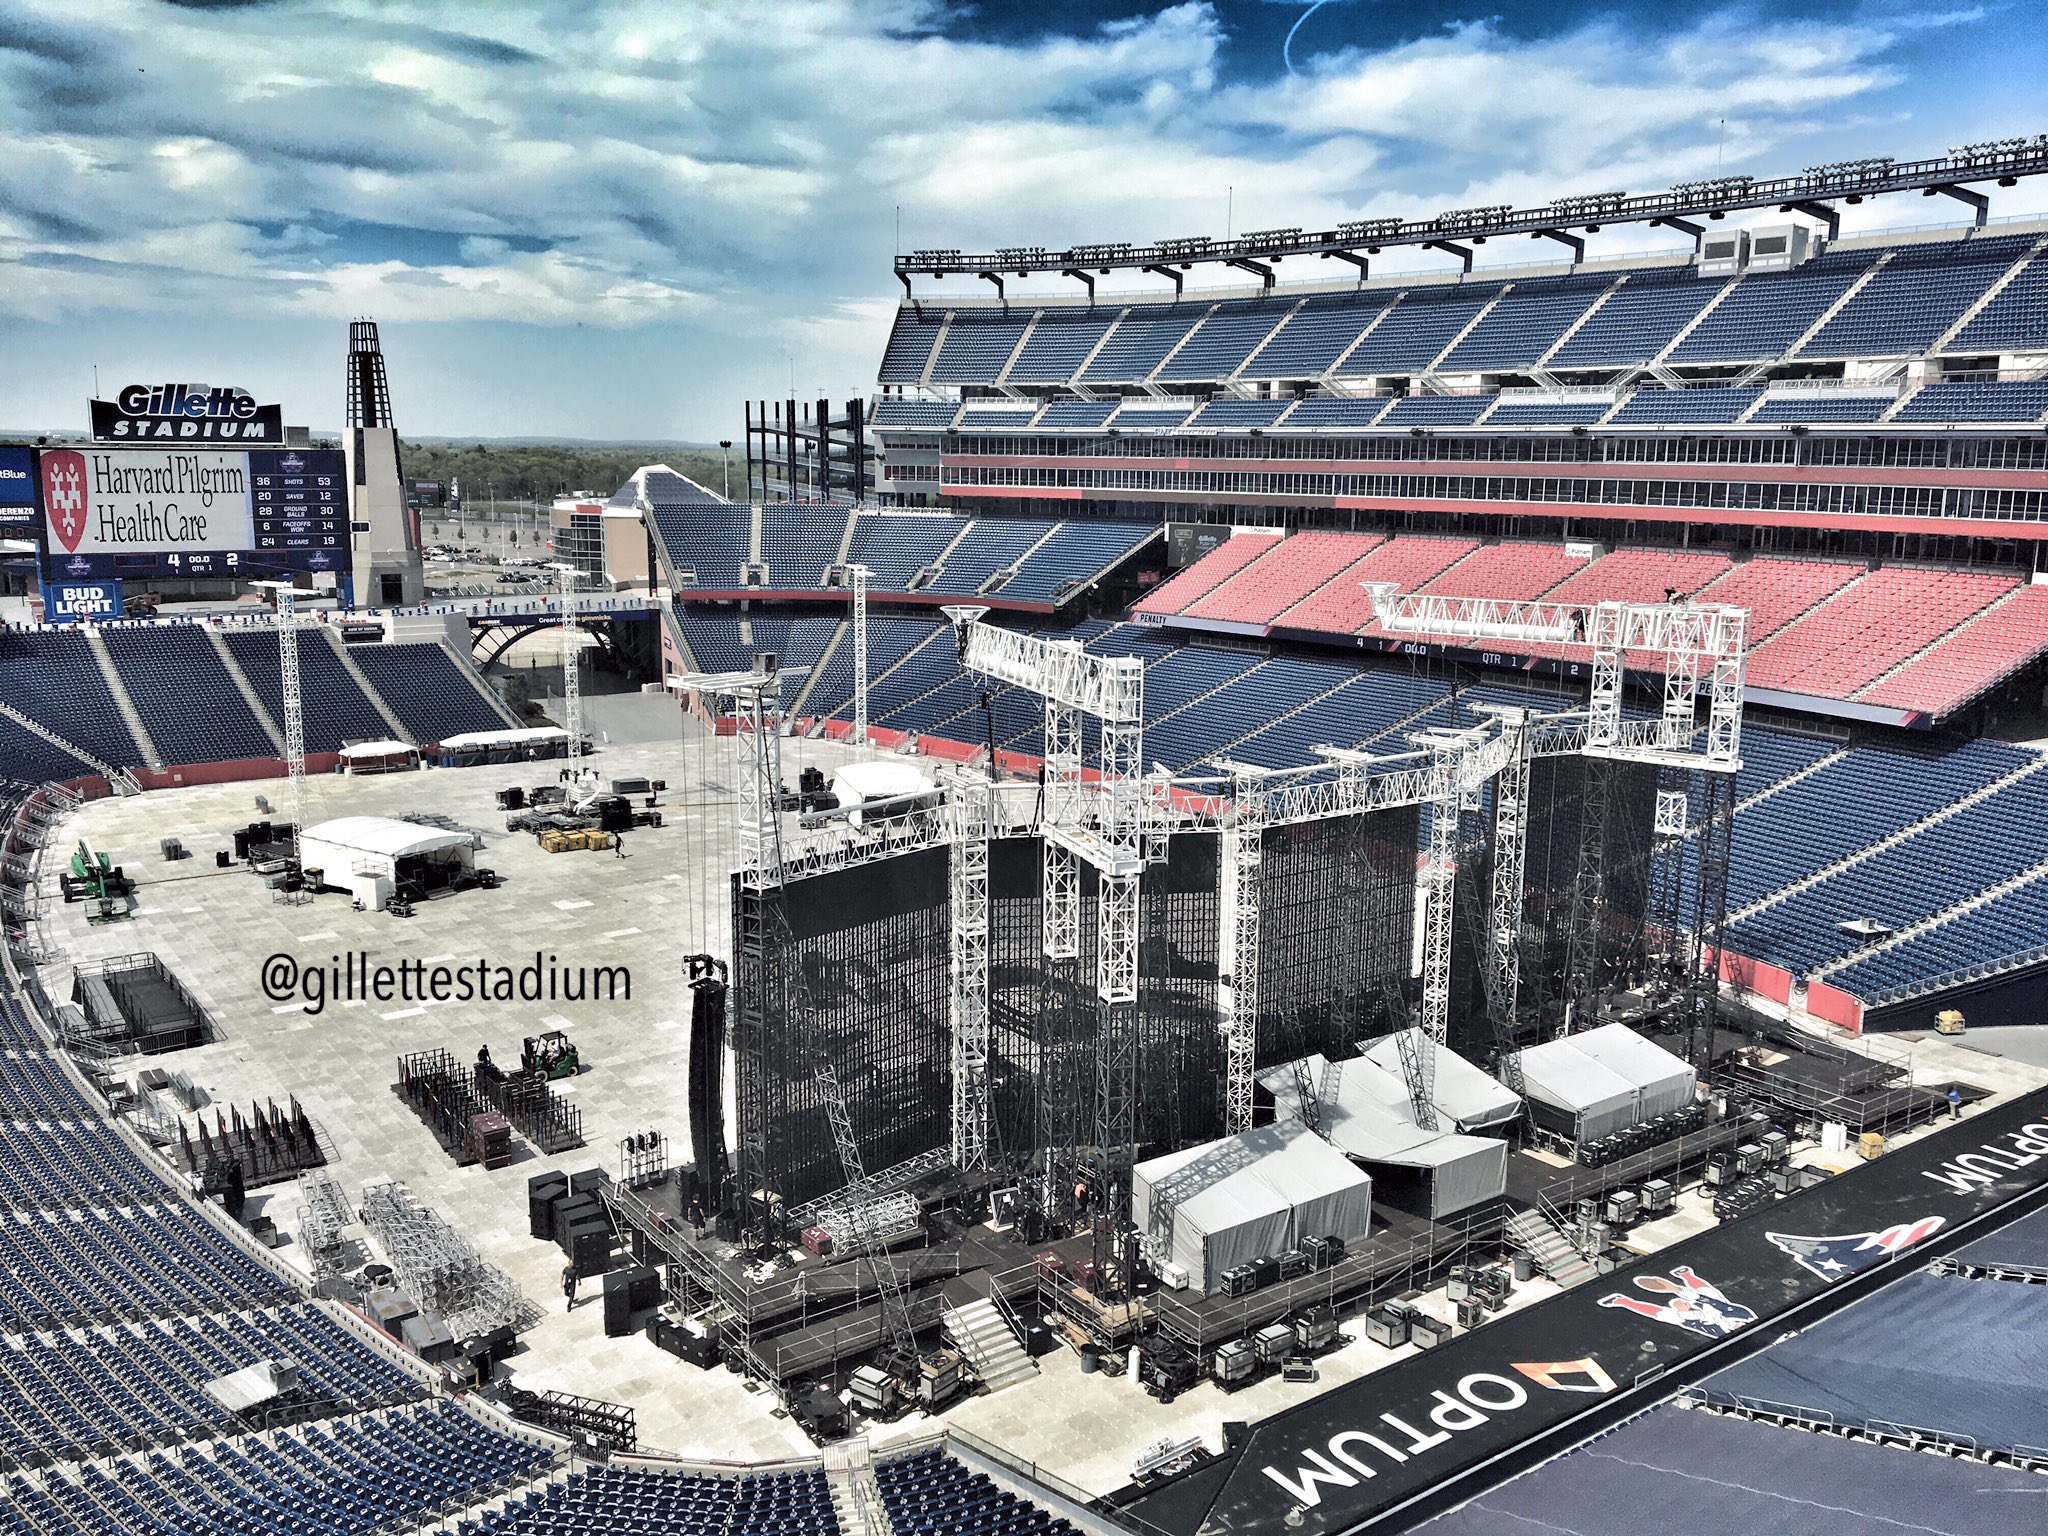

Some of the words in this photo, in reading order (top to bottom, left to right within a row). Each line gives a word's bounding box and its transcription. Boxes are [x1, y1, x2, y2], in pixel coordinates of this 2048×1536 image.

[117, 383, 258, 418] Gillette
[113, 420, 265, 438] STADIUM
[92, 455, 175, 494] Harvard
[175, 455, 245, 507] Pilgrim
[256, 477, 270, 485] 36
[318, 477, 330, 485] 53
[258, 492, 271, 500] 20
[320, 492, 331, 500] 12
[259, 507, 272, 515] 28
[320, 507, 333, 515] 30
[263, 522, 270, 530] 6
[262, 537, 275, 546] 24
[168, 554, 180, 566] 4
[226, 553, 238, 565] 2
[63, 587, 104, 600] BUD
[56, 600, 112, 614] LIGHT
[1140, 614, 1167, 624] PENALTY
[1357, 638, 1363, 647] 4
[1379, 641, 1382, 650] 1
[1482, 653, 1501, 664] QTR
[1512, 656, 1517, 667] 1
[1552, 663, 1556, 672] 1
[1570, 664, 1578, 675] 2
[1261, 1373, 1528, 1507] OPTUM
